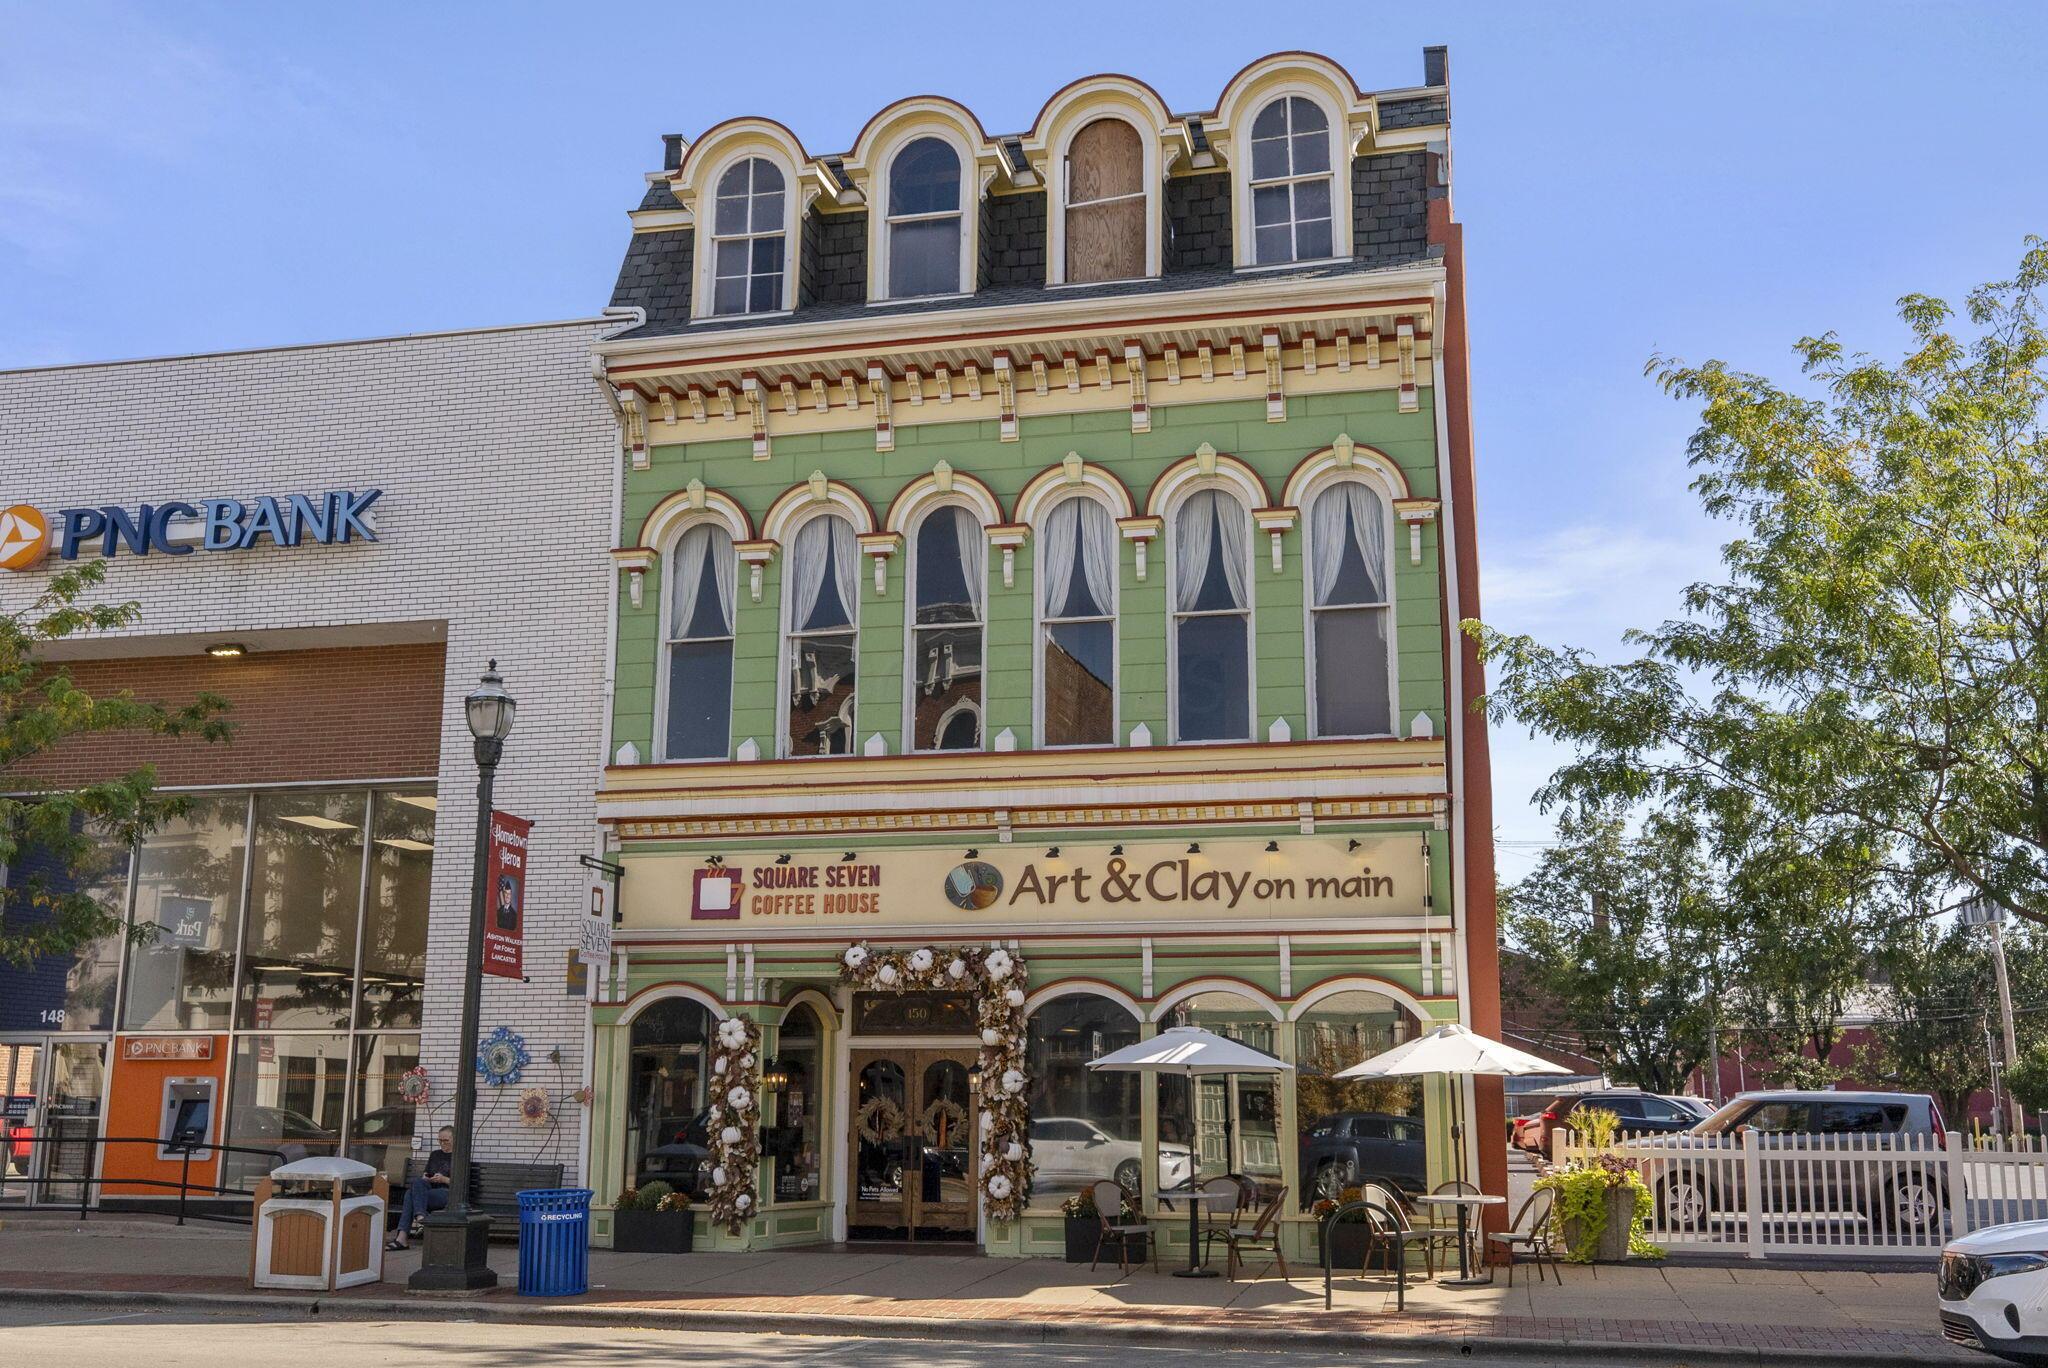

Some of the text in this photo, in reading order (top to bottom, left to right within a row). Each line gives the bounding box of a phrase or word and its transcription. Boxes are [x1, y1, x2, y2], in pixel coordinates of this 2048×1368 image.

[492, 824, 528, 849] Hometown
[753, 865, 881, 889] SQUARE SEVEN
[1008, 857, 1394, 909] Art & Clay on main
[751, 893, 880, 915] COFFEE HOUSE
[581, 919, 611, 938] SQUARE
[580, 934, 610, 952] SEVEN
[40, 1009, 66, 1023] 148
[908, 1008, 927, 1019] 150
[547, 1212, 583, 1221] RECYCLING
